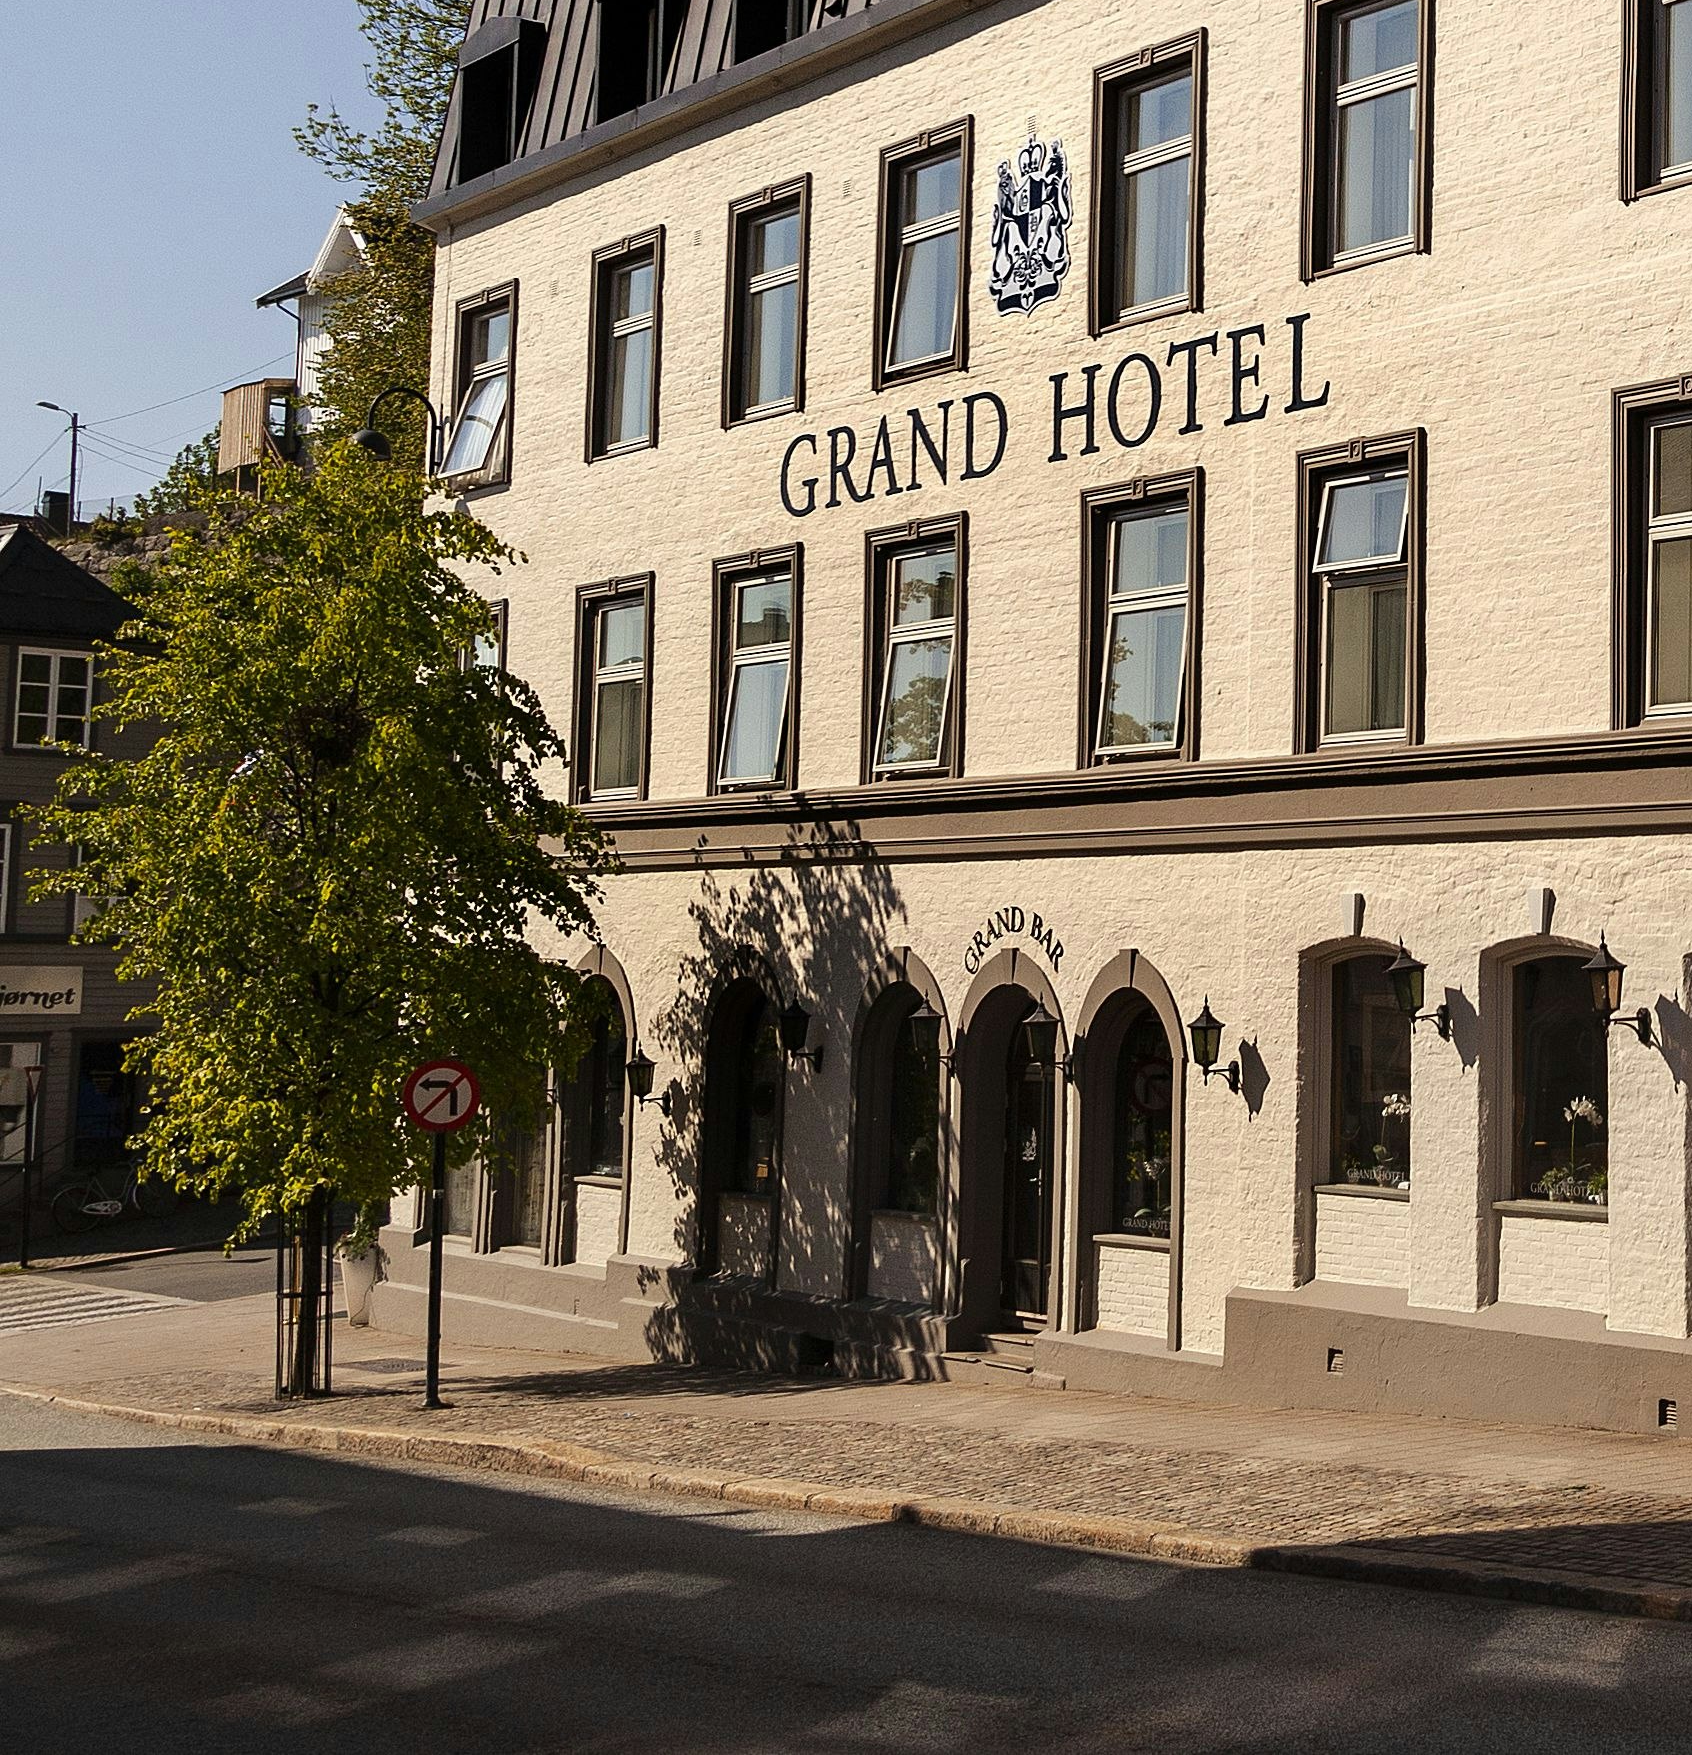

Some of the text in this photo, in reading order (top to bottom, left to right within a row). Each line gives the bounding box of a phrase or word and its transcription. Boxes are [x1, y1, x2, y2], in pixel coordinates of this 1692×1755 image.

[780, 312, 1331, 517] GRAND HOTEL
[965, 906, 1065, 975] GRAND BAR
[1122, 1217, 1148, 1229] GRAND
